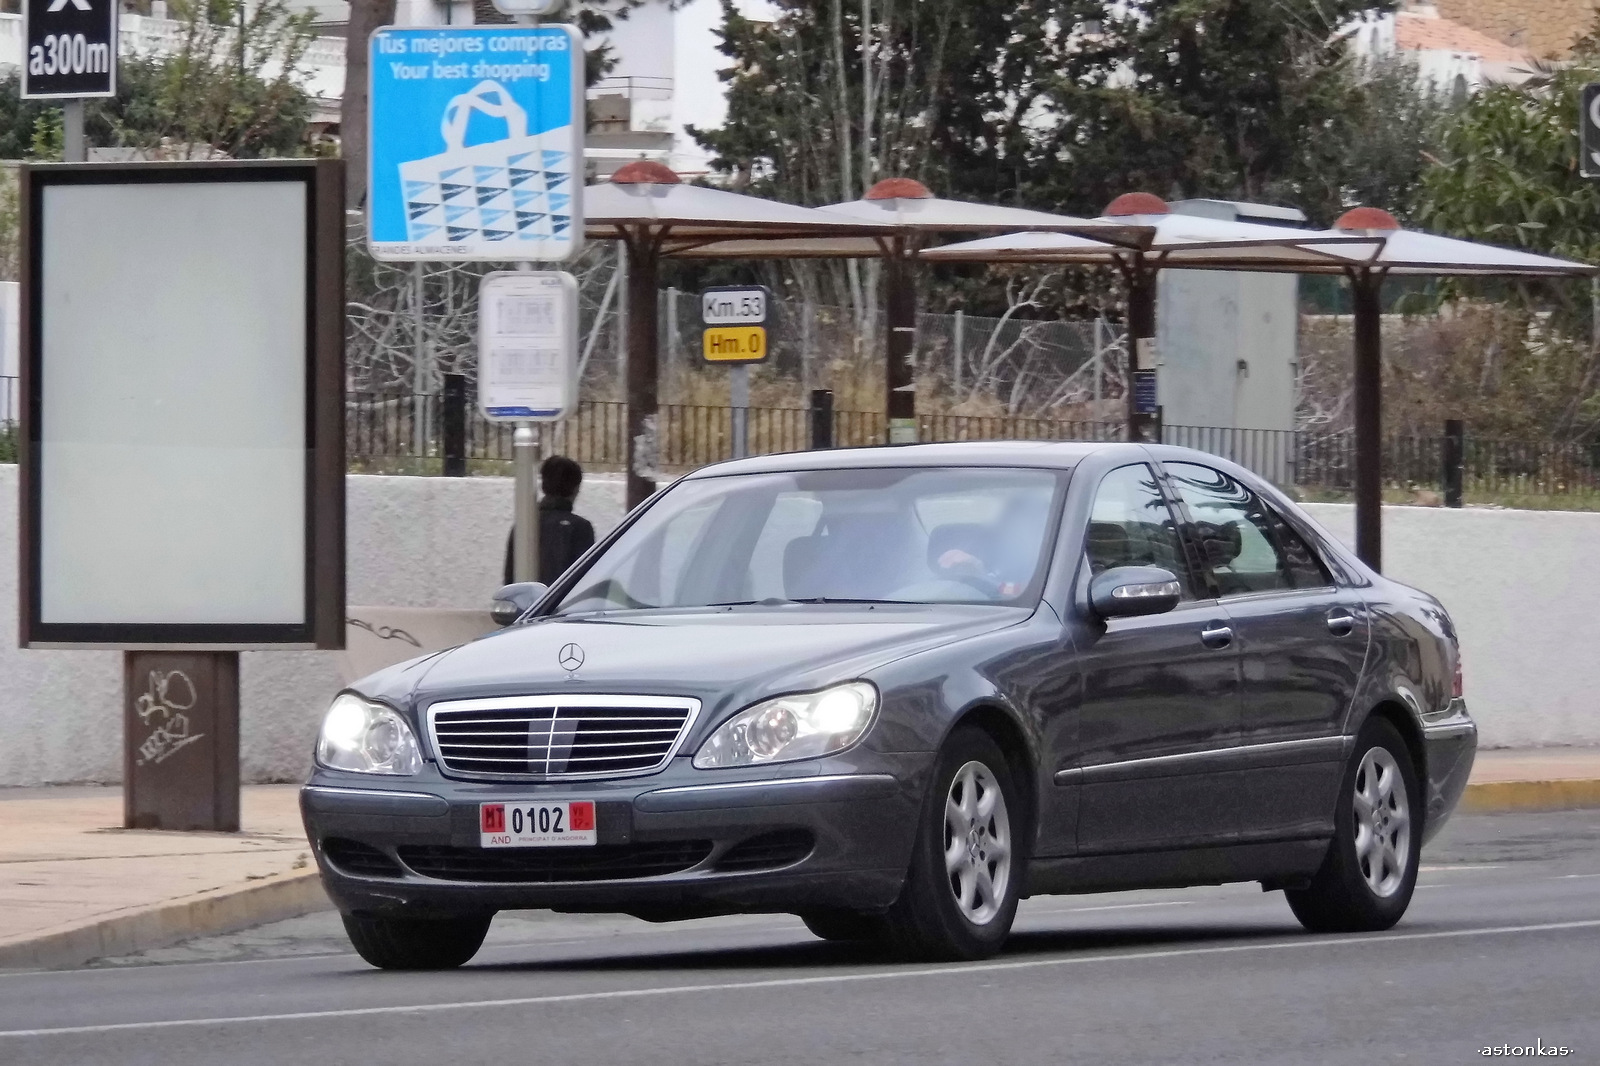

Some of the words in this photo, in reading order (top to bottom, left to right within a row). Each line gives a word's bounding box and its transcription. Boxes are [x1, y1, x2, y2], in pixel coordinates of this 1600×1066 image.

[30, 33, 109, 76] a300m
[376, 33, 407, 53] Tus
[411, 33, 485, 57] mejores
[488, 35, 567, 56] compras
[390, 62, 429, 80] Your
[433, 60, 468, 79] best
[472, 60, 549, 81] shopping
[703, 297, 761, 317] Km.53
[512, 807, 564, 834] 0102
[491, 836, 511, 845] AND
